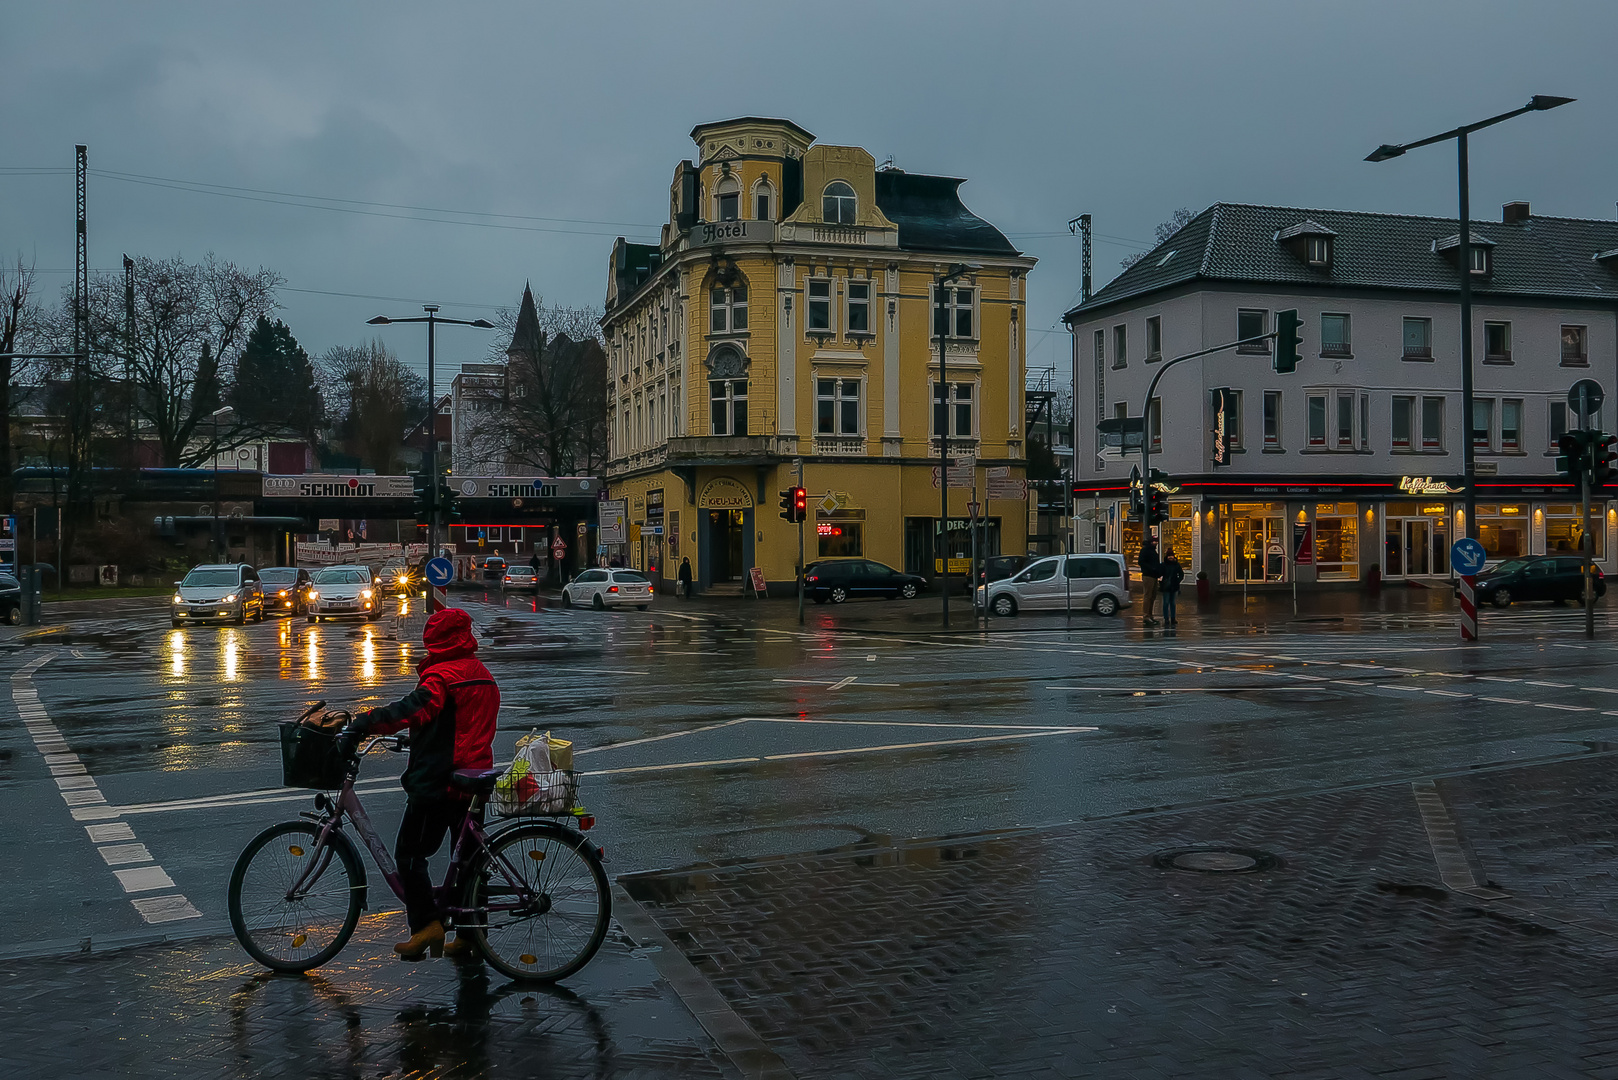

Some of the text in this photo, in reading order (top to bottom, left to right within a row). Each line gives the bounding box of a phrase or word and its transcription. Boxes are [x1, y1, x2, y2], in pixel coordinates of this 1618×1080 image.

[703, 222, 747, 244] Hotel
[300, 480, 376, 496] SCHMIDT
[488, 481, 559, 497] SCHMIDT
